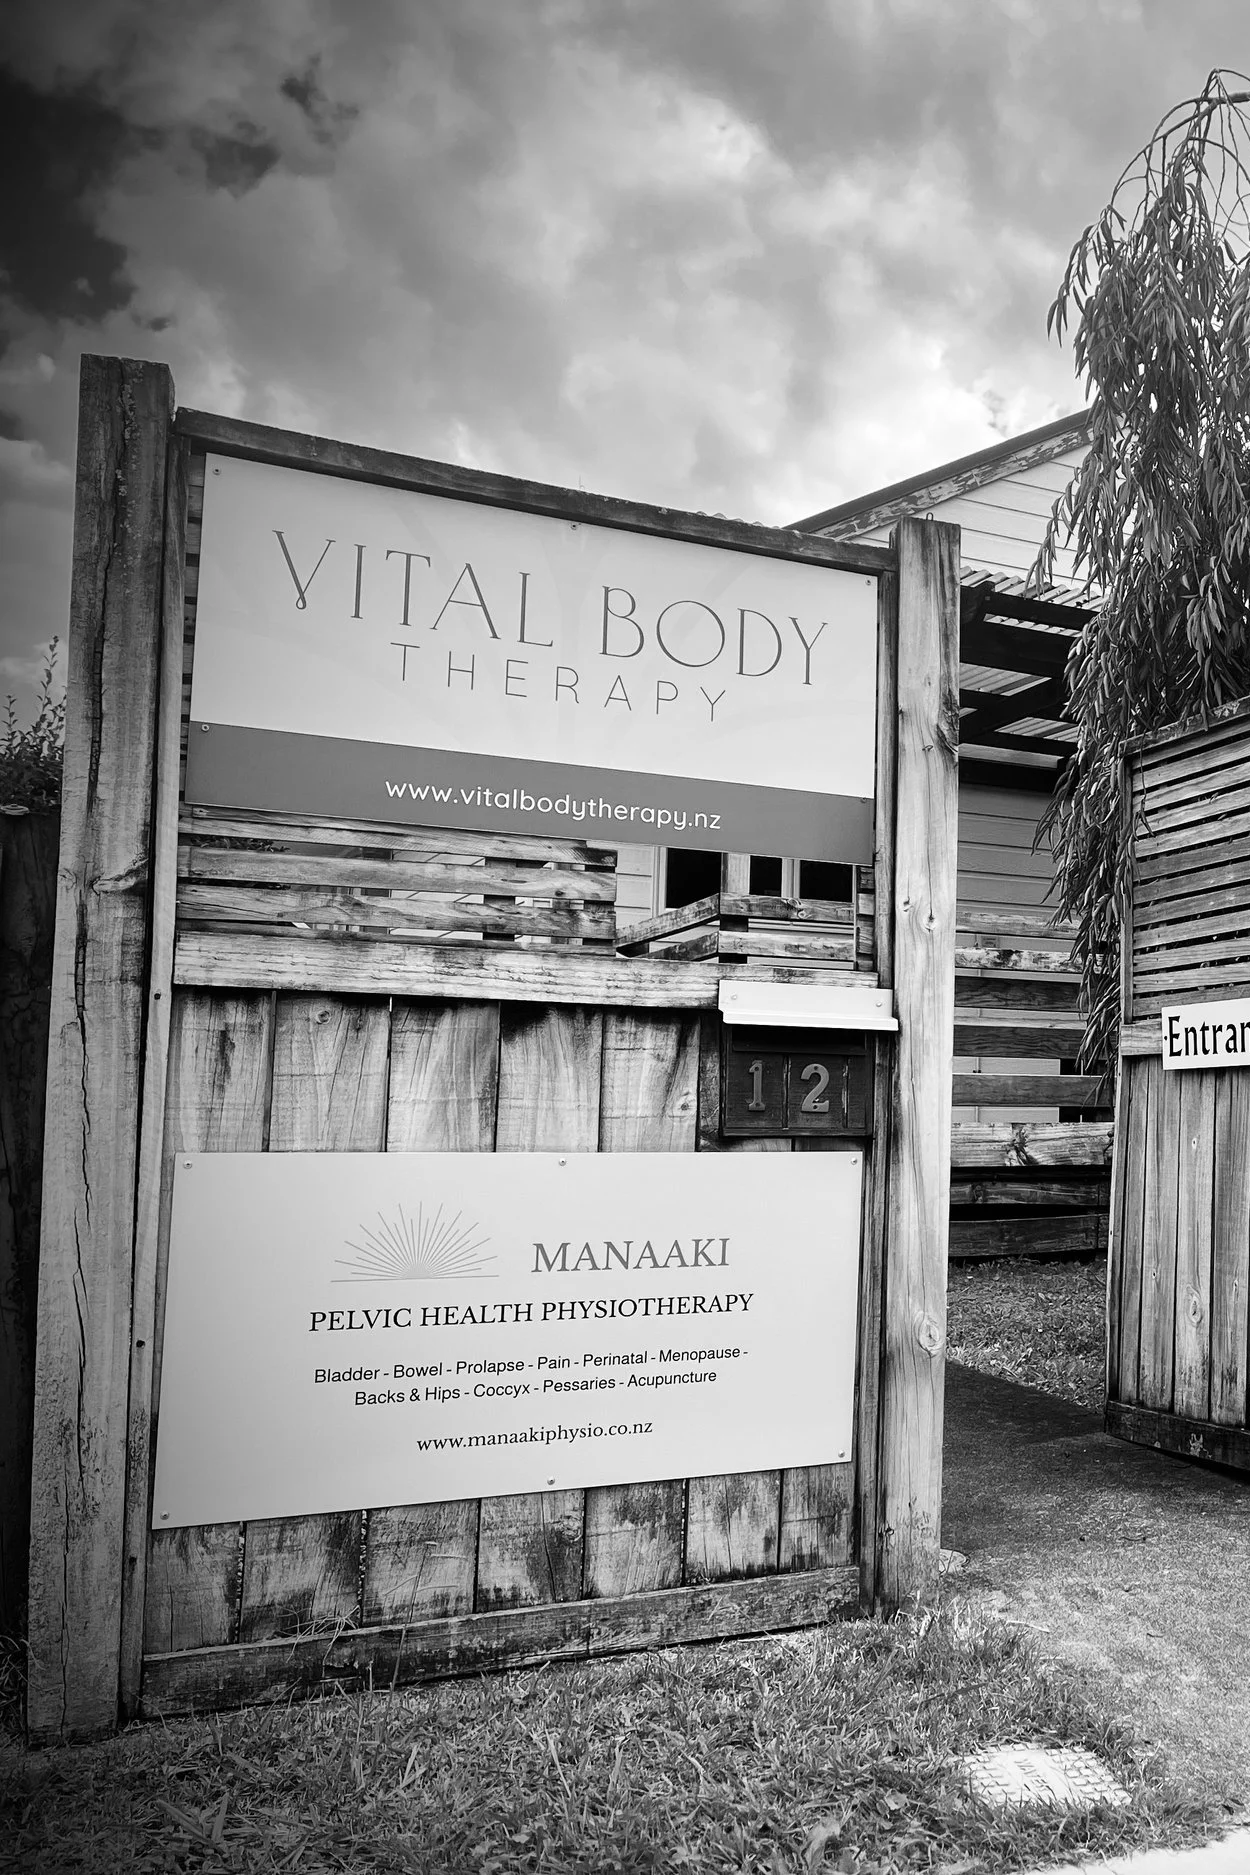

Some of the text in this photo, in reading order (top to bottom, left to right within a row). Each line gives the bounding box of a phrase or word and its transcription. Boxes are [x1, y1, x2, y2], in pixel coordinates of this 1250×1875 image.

[272, 529, 829, 686] VITAL BODY
[390, 642, 727, 722] THERAPY
[385, 781, 721, 831] www.vitalbodytherapy.nz
[530, 1237, 731, 1273] MANAAKI
[308, 1292, 755, 1332] PELVIC HEALTH PHYSIOTHERAPY
[314, 1368, 381, 1384] Bladder
[393, 1361, 443, 1379] Bowel
[455, 1359, 525, 1377] Prolapse
[537, 1356, 571, 1370] Pain
[582, 1350, 648, 1368] Perinatal
[658, 1347, 741, 1364] Menopause
[354, 1389, 406, 1406] Backs
[409, 1387, 421, 1402] &
[424, 1385, 461, 1404] Hips
[473, 1383, 531, 1399] Coccyx
[542, 1378, 616, 1394] Pessaries
[626, 1370, 717, 1390] Acupuncture
[416, 1422, 653, 1452] www.manaakiphysio.co.nz
